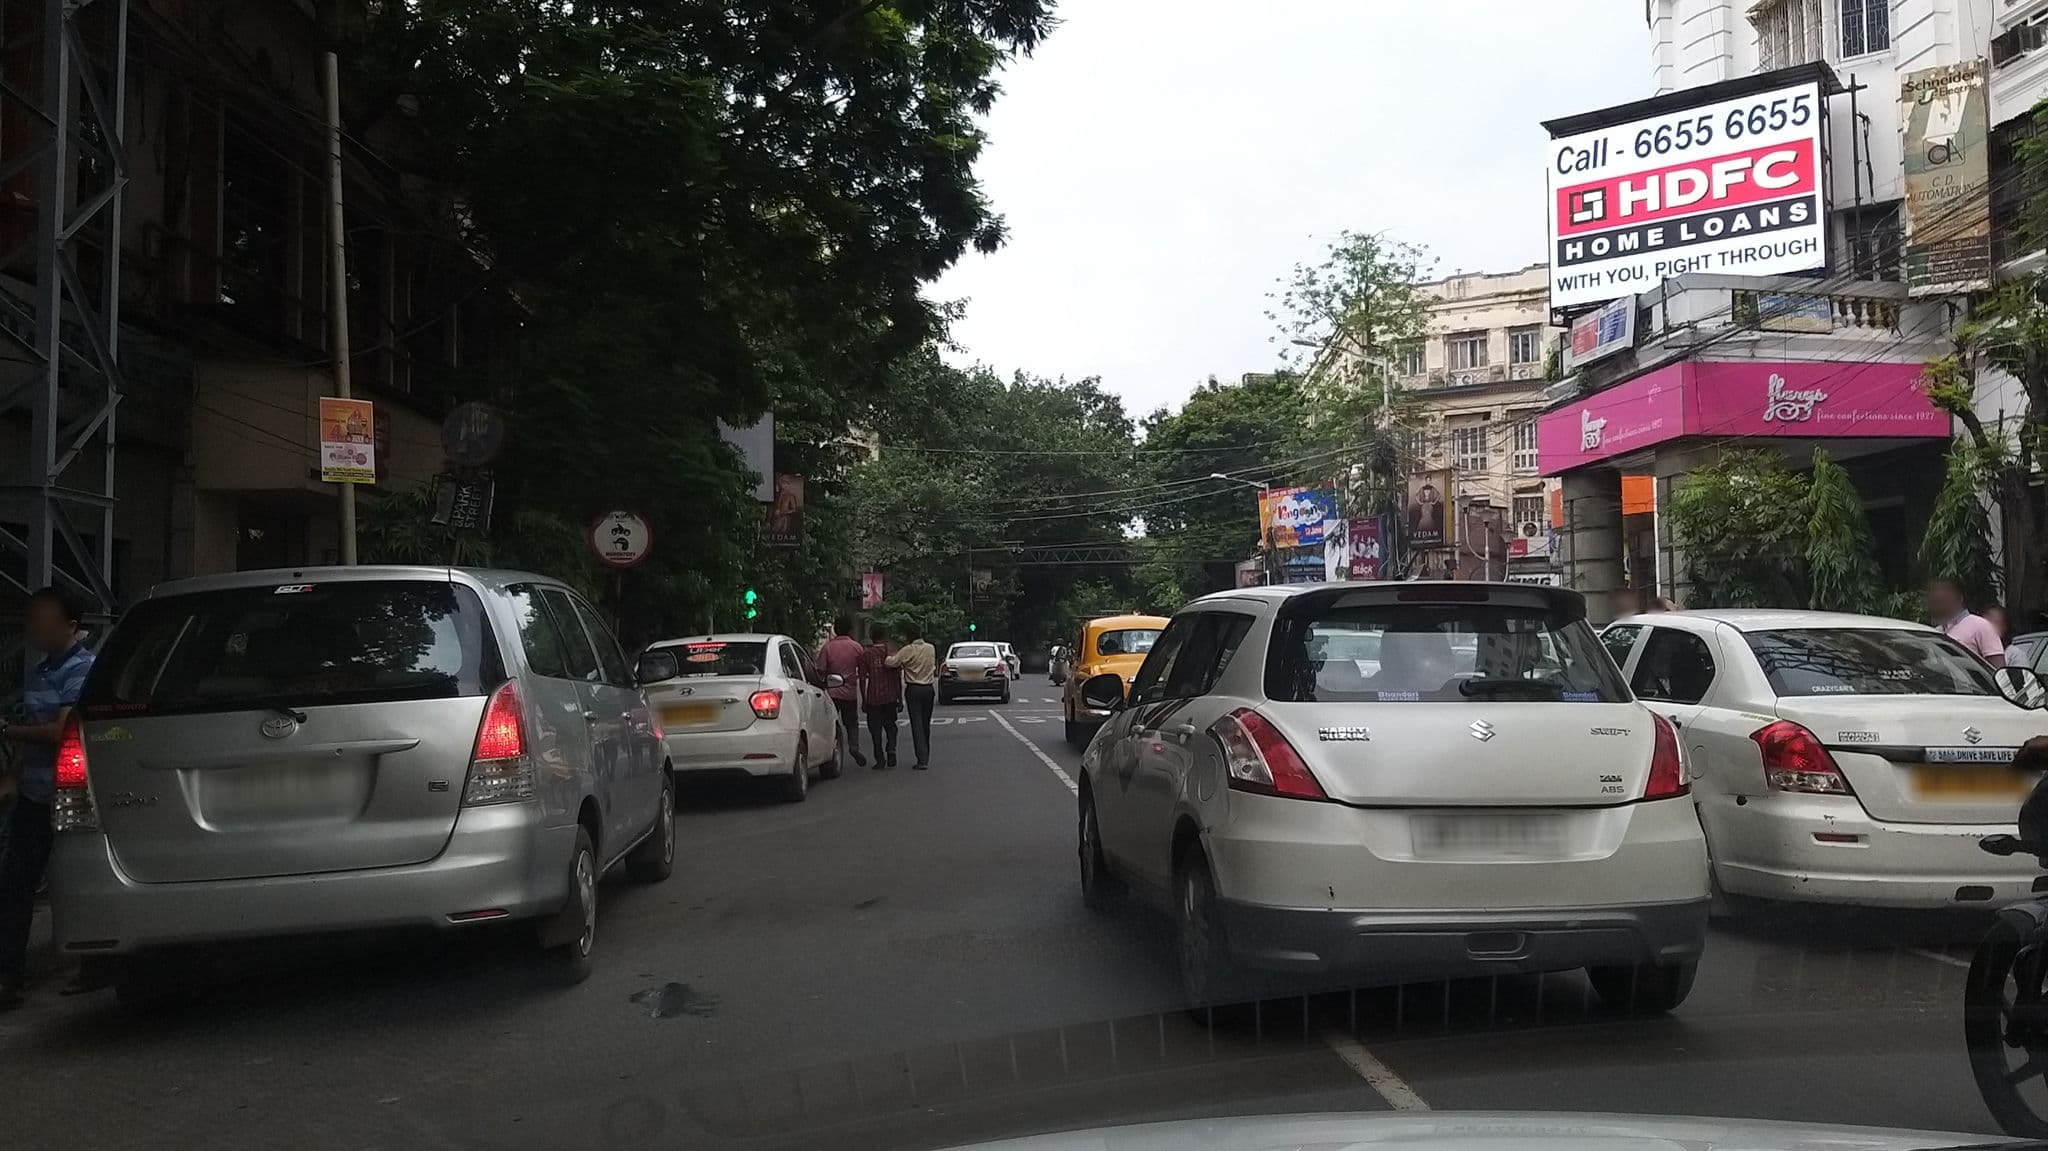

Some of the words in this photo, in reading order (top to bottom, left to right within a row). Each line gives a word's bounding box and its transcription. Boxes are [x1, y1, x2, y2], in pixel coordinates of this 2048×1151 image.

[1906, 72, 1977, 93] Schneider
[1939, 82, 1977, 97] Electric
[1556, 137, 1609, 175] Call
[1634, 115, 1714, 158] 6655
[1724, 93, 1812, 140] 6655
[1618, 149, 1801, 217] HDFC
[1564, 228, 1664, 261] HOME
[1680, 200, 1809, 242] LOANS
[1557, 271, 1601, 293] WITH
[1606, 262, 1650, 285] YOU,
[1717, 236, 1818, 269] THROUGH
[1817, 408, 1835, 423] fine
[1837, 408, 1888, 423] confections
[1890, 411, 1913, 421] since
[1916, 411, 1935, 422] 1927
[452, 485, 473, 519] PARK
[464, 486, 481, 529] STREET
[1413, 530, 1439, 539] VEDAM
[1319, 733, 1370, 741] SUZUKI
[1590, 727, 1632, 736] SWIFT
[1957, 750, 1977, 761] DRIVE
[1979, 751, 1996, 761] SAVE
[1997, 751, 2012, 761] LIFE
[1600, 785, 1625, 794] ABS
